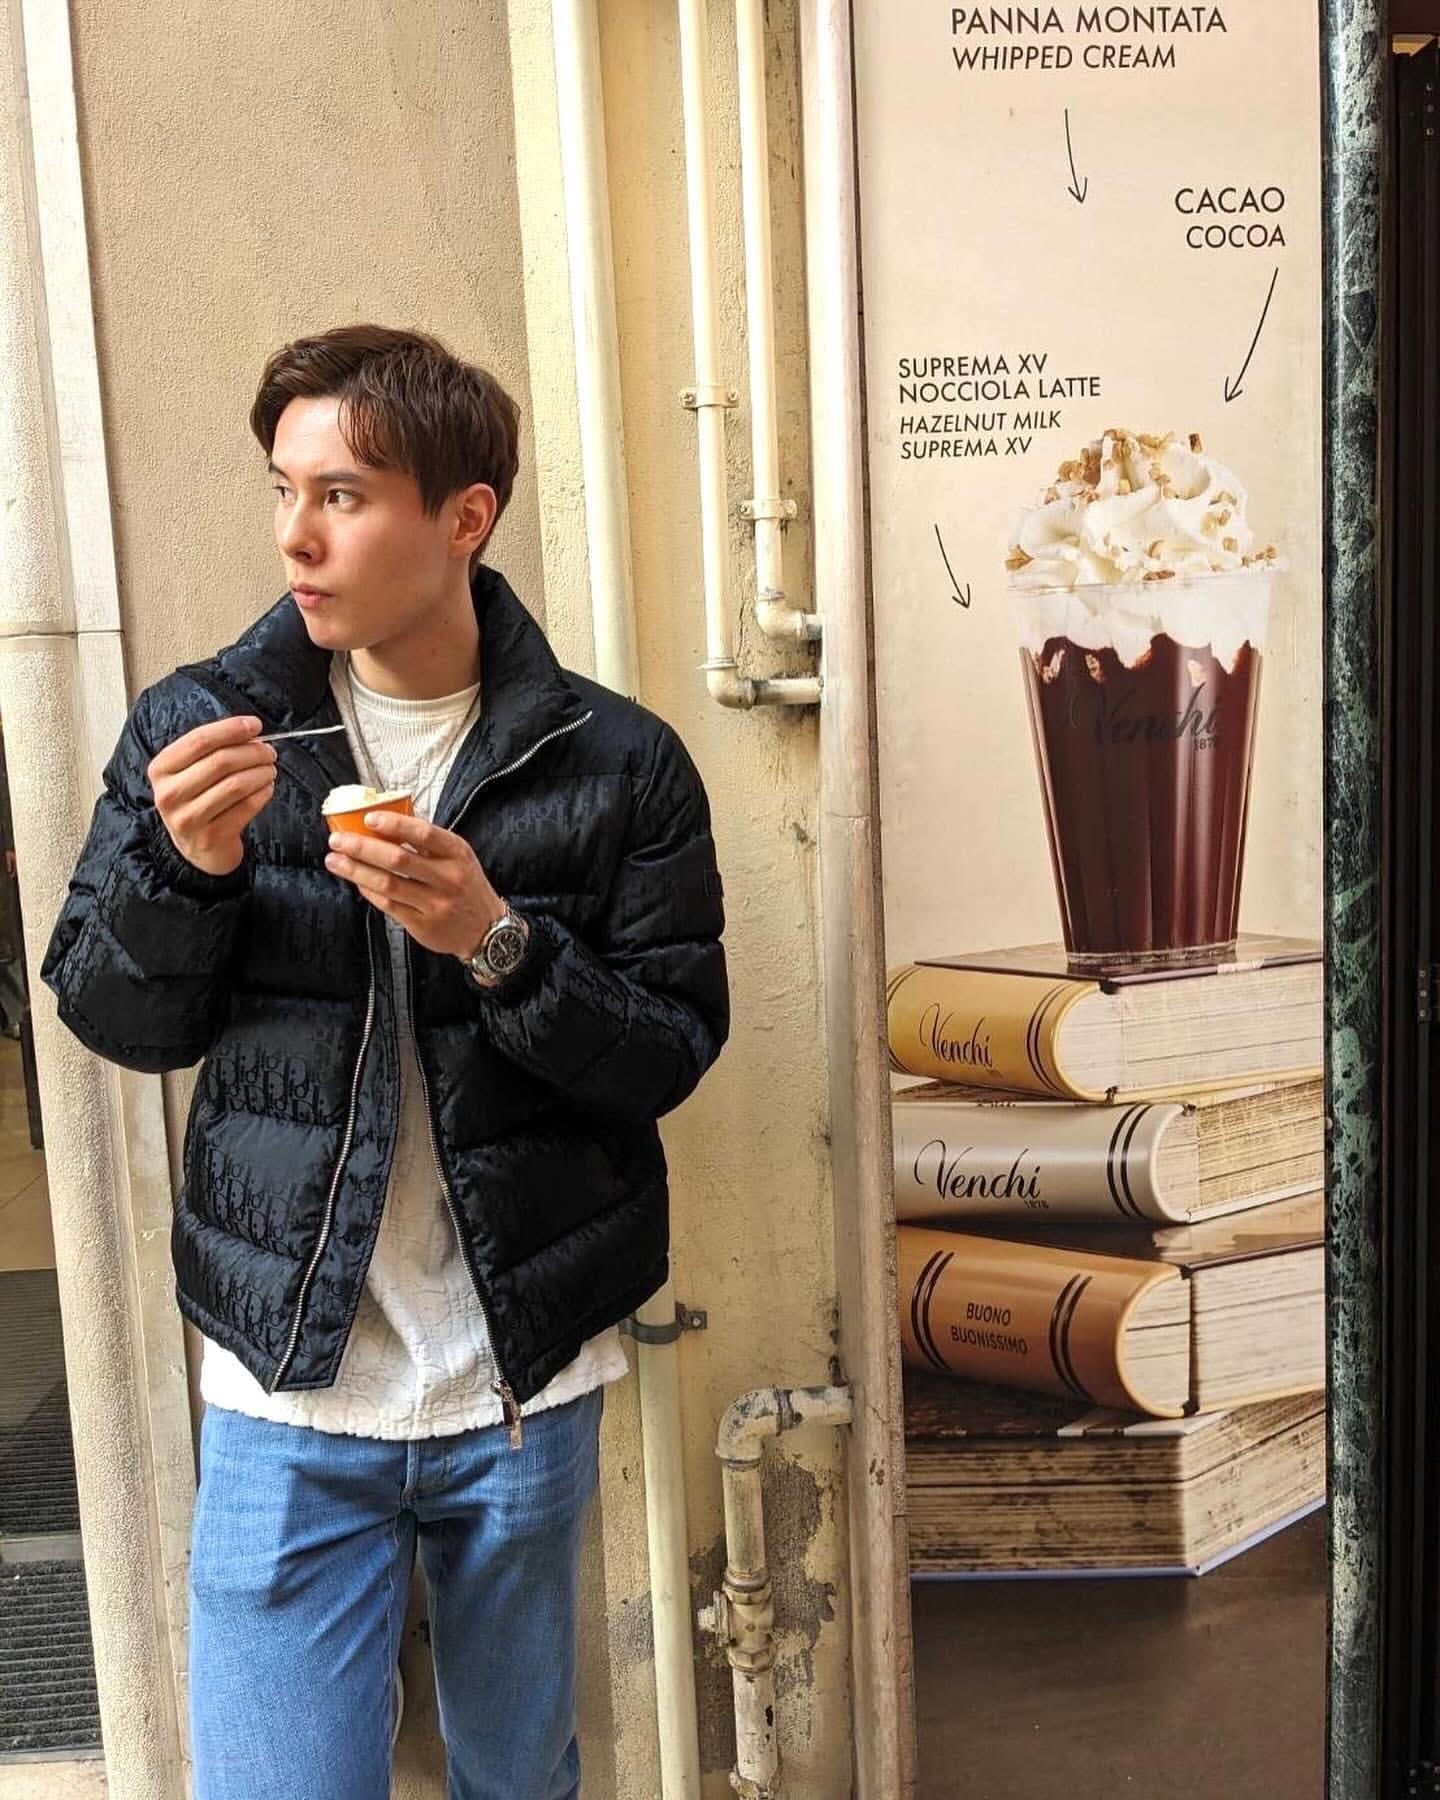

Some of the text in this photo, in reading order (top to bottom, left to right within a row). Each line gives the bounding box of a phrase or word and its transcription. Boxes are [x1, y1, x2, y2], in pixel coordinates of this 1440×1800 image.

[951, 6, 1228, 36] PANNA MONTATA
[952, 44, 1176, 71] WHIPPED CREAM
[1174, 186, 1286, 215] CACAO
[1185, 223, 1286, 250] COCOA
[899, 353, 1048, 379] SUPREMA XV
[899, 376, 1101, 404] NOCCIOLA LATTE
[899, 410, 1062, 435] HAZELNUT MILK
[900, 436, 1033, 460] SUPREMA XV
[919, 1003, 993, 1068] Venchi
[914, 1139, 1041, 1200] Venchi
[966, 1302, 1012, 1327] BUONO
[950, 1325, 1029, 1355] BUONISSIMO
